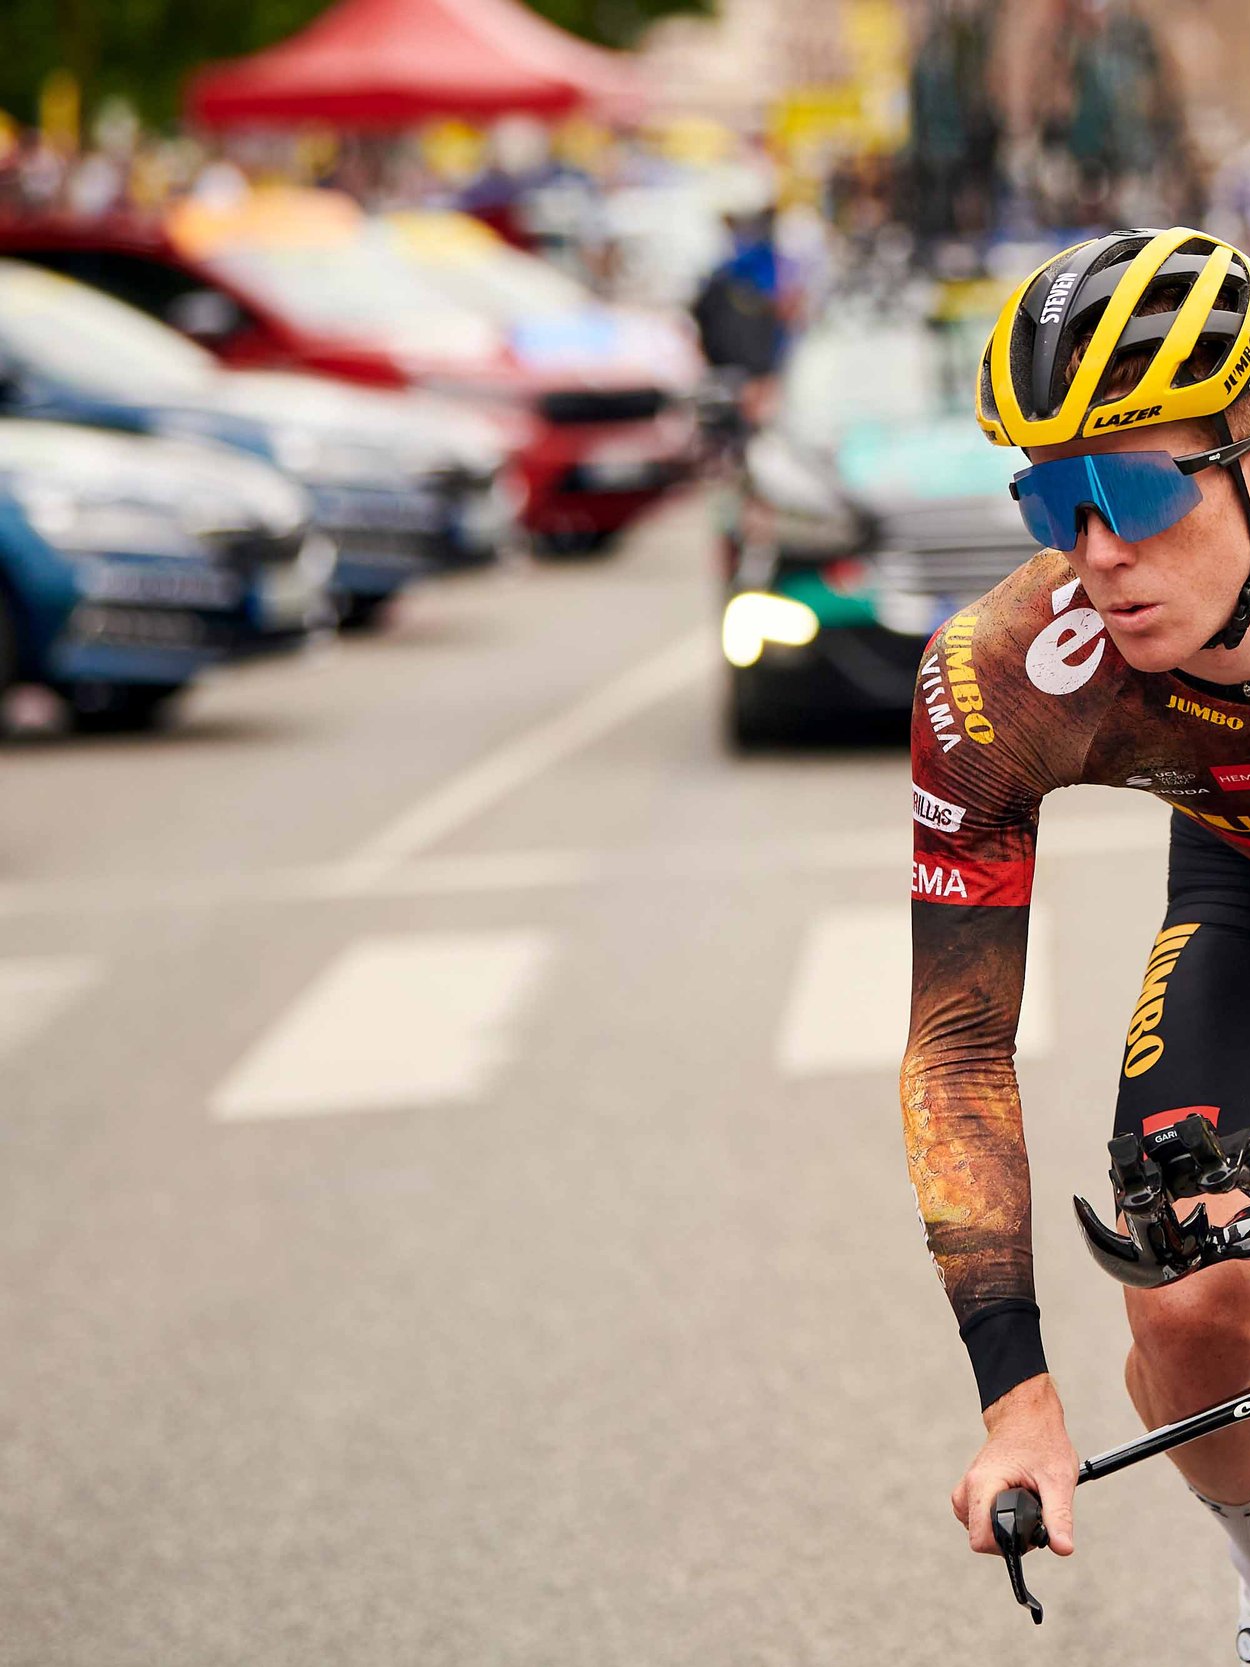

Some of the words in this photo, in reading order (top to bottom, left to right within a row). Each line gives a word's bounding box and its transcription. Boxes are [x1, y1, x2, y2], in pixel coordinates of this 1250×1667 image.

[1040, 273, 1077, 324] STEVEN
[1093, 405, 1163, 430] LAZER
[921, 653, 962, 753] VISMA
[945, 614, 995, 745] JUMBO
[1165, 694, 1245, 731] JUMBO
